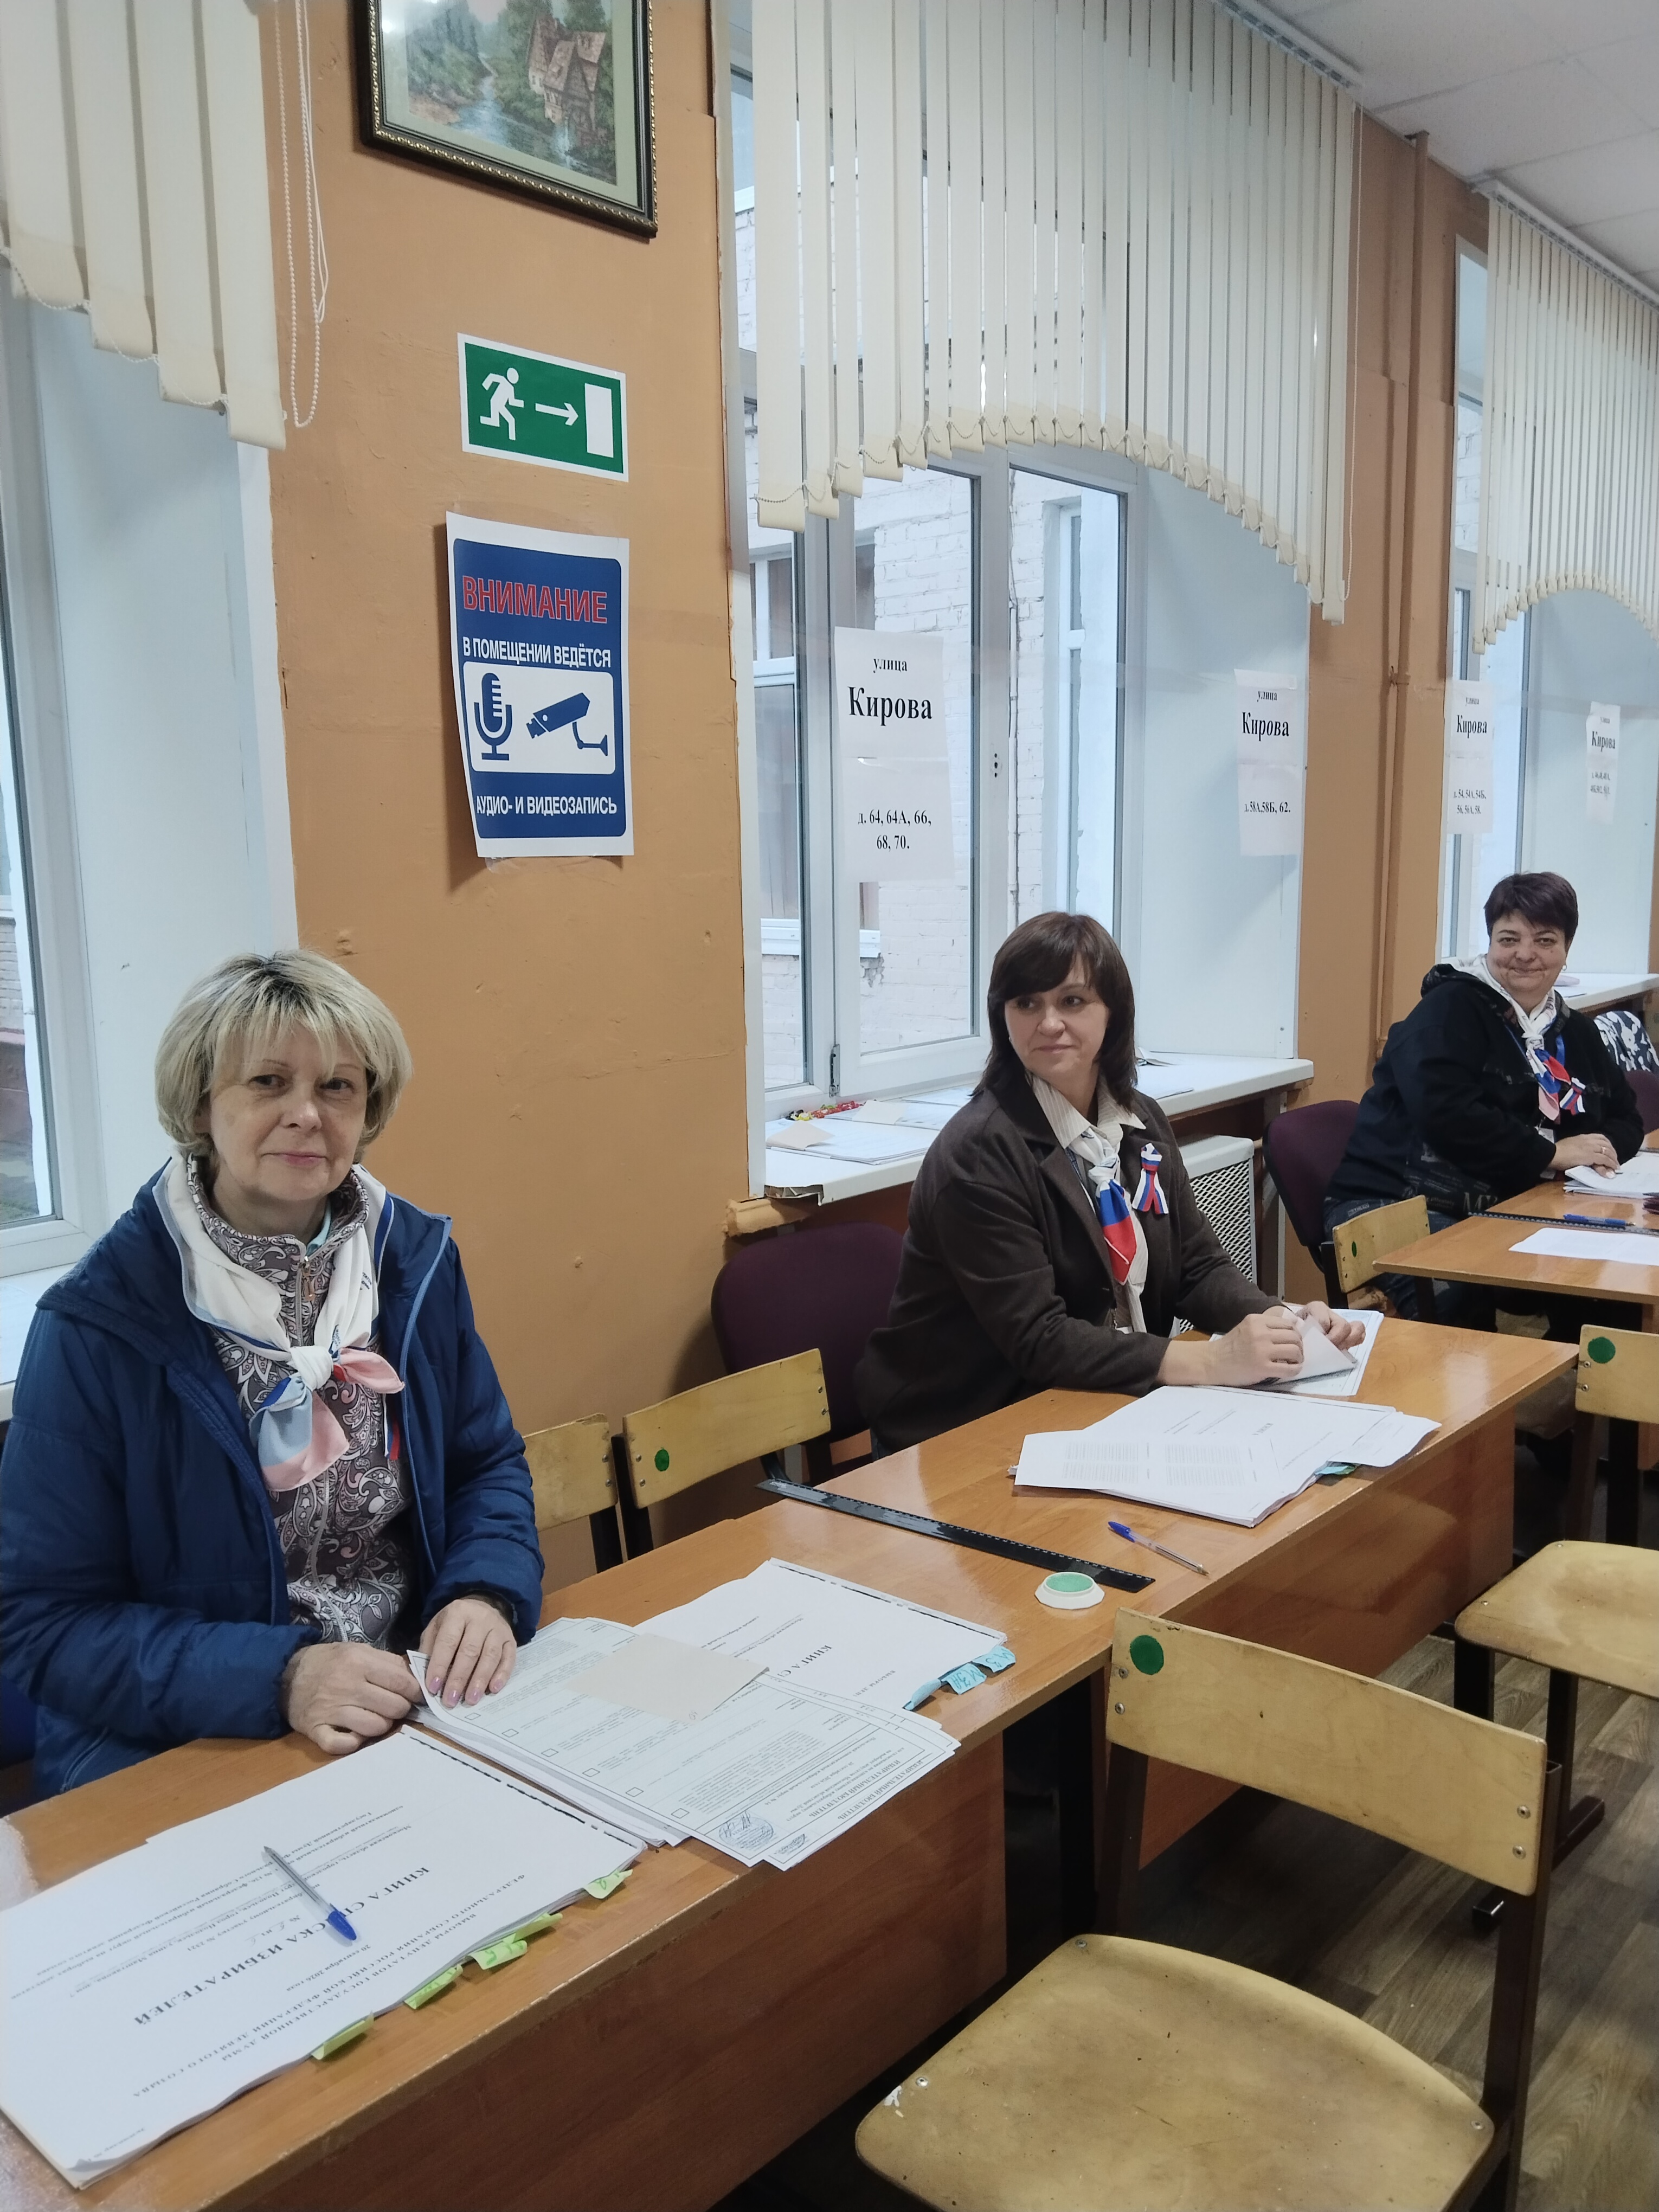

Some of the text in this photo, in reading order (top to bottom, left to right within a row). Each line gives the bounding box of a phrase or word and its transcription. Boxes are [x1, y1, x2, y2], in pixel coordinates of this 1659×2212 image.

[462, 576, 607, 623] ВНИМАНИЕ
[463, 636, 611, 668] В ПОМЕЩЕНИИ ВЕДЁТСЯ
[873, 657, 908, 673] улица
[847, 686, 933, 726] Кирова
[1257, 690, 1277, 702] улица
[1242, 712, 1289, 741] Кирова
[1457, 715, 1487, 738] Кирова
[1592, 731, 1615, 752] Кирова
[477, 796, 617, 815] АУДИО- И ВИДЕОЗАПИСЬ
[858, 809, 931, 827] д. 64, 64А, 66,
[1279, 802, 1290, 812] 62.
[877, 834, 910, 851] 68, 70.
[792, 1645, 832, 1668] КНИГА
[869, 1670, 895, 1687] ВЫБОРЫ
[809, 1760, 901, 1817] ИЗБИРАТЕЛЬНЫЙ БЮЛЛЕТЕНЬ
[838, 1760, 923, 1819] ИЗБИРАТЕЛЬНЫЙ БЮЛЛЕТЕНЬ
[368, 1868, 429, 1899] КНИГА
[452, 1875, 524, 1918] ФЕДЕРАЛЬНОГО
[250, 1892, 305, 1919] бирательному
[397, 1920, 449, 1951] СОБРАНИЯ
[324, 1952, 394, 1993] РОССИЙСКОЙ
[325, 1951, 359, 1970] сентября
[135, 1945, 282, 2024] ИЗБИРАТЕЛЕЙ
[222, 1914, 476, 2061] ВЫБОРЫ ДЕПУТАТОВ ГОСУДАРСТВЕННОЙ ДУМЫ
[253, 1995, 319, 2032] ФЕДЕРАЦИИ
[188, 2033, 247, 2067] ДЕВЯТОГО
[134, 2069, 183, 2097] СОЗЫВА
